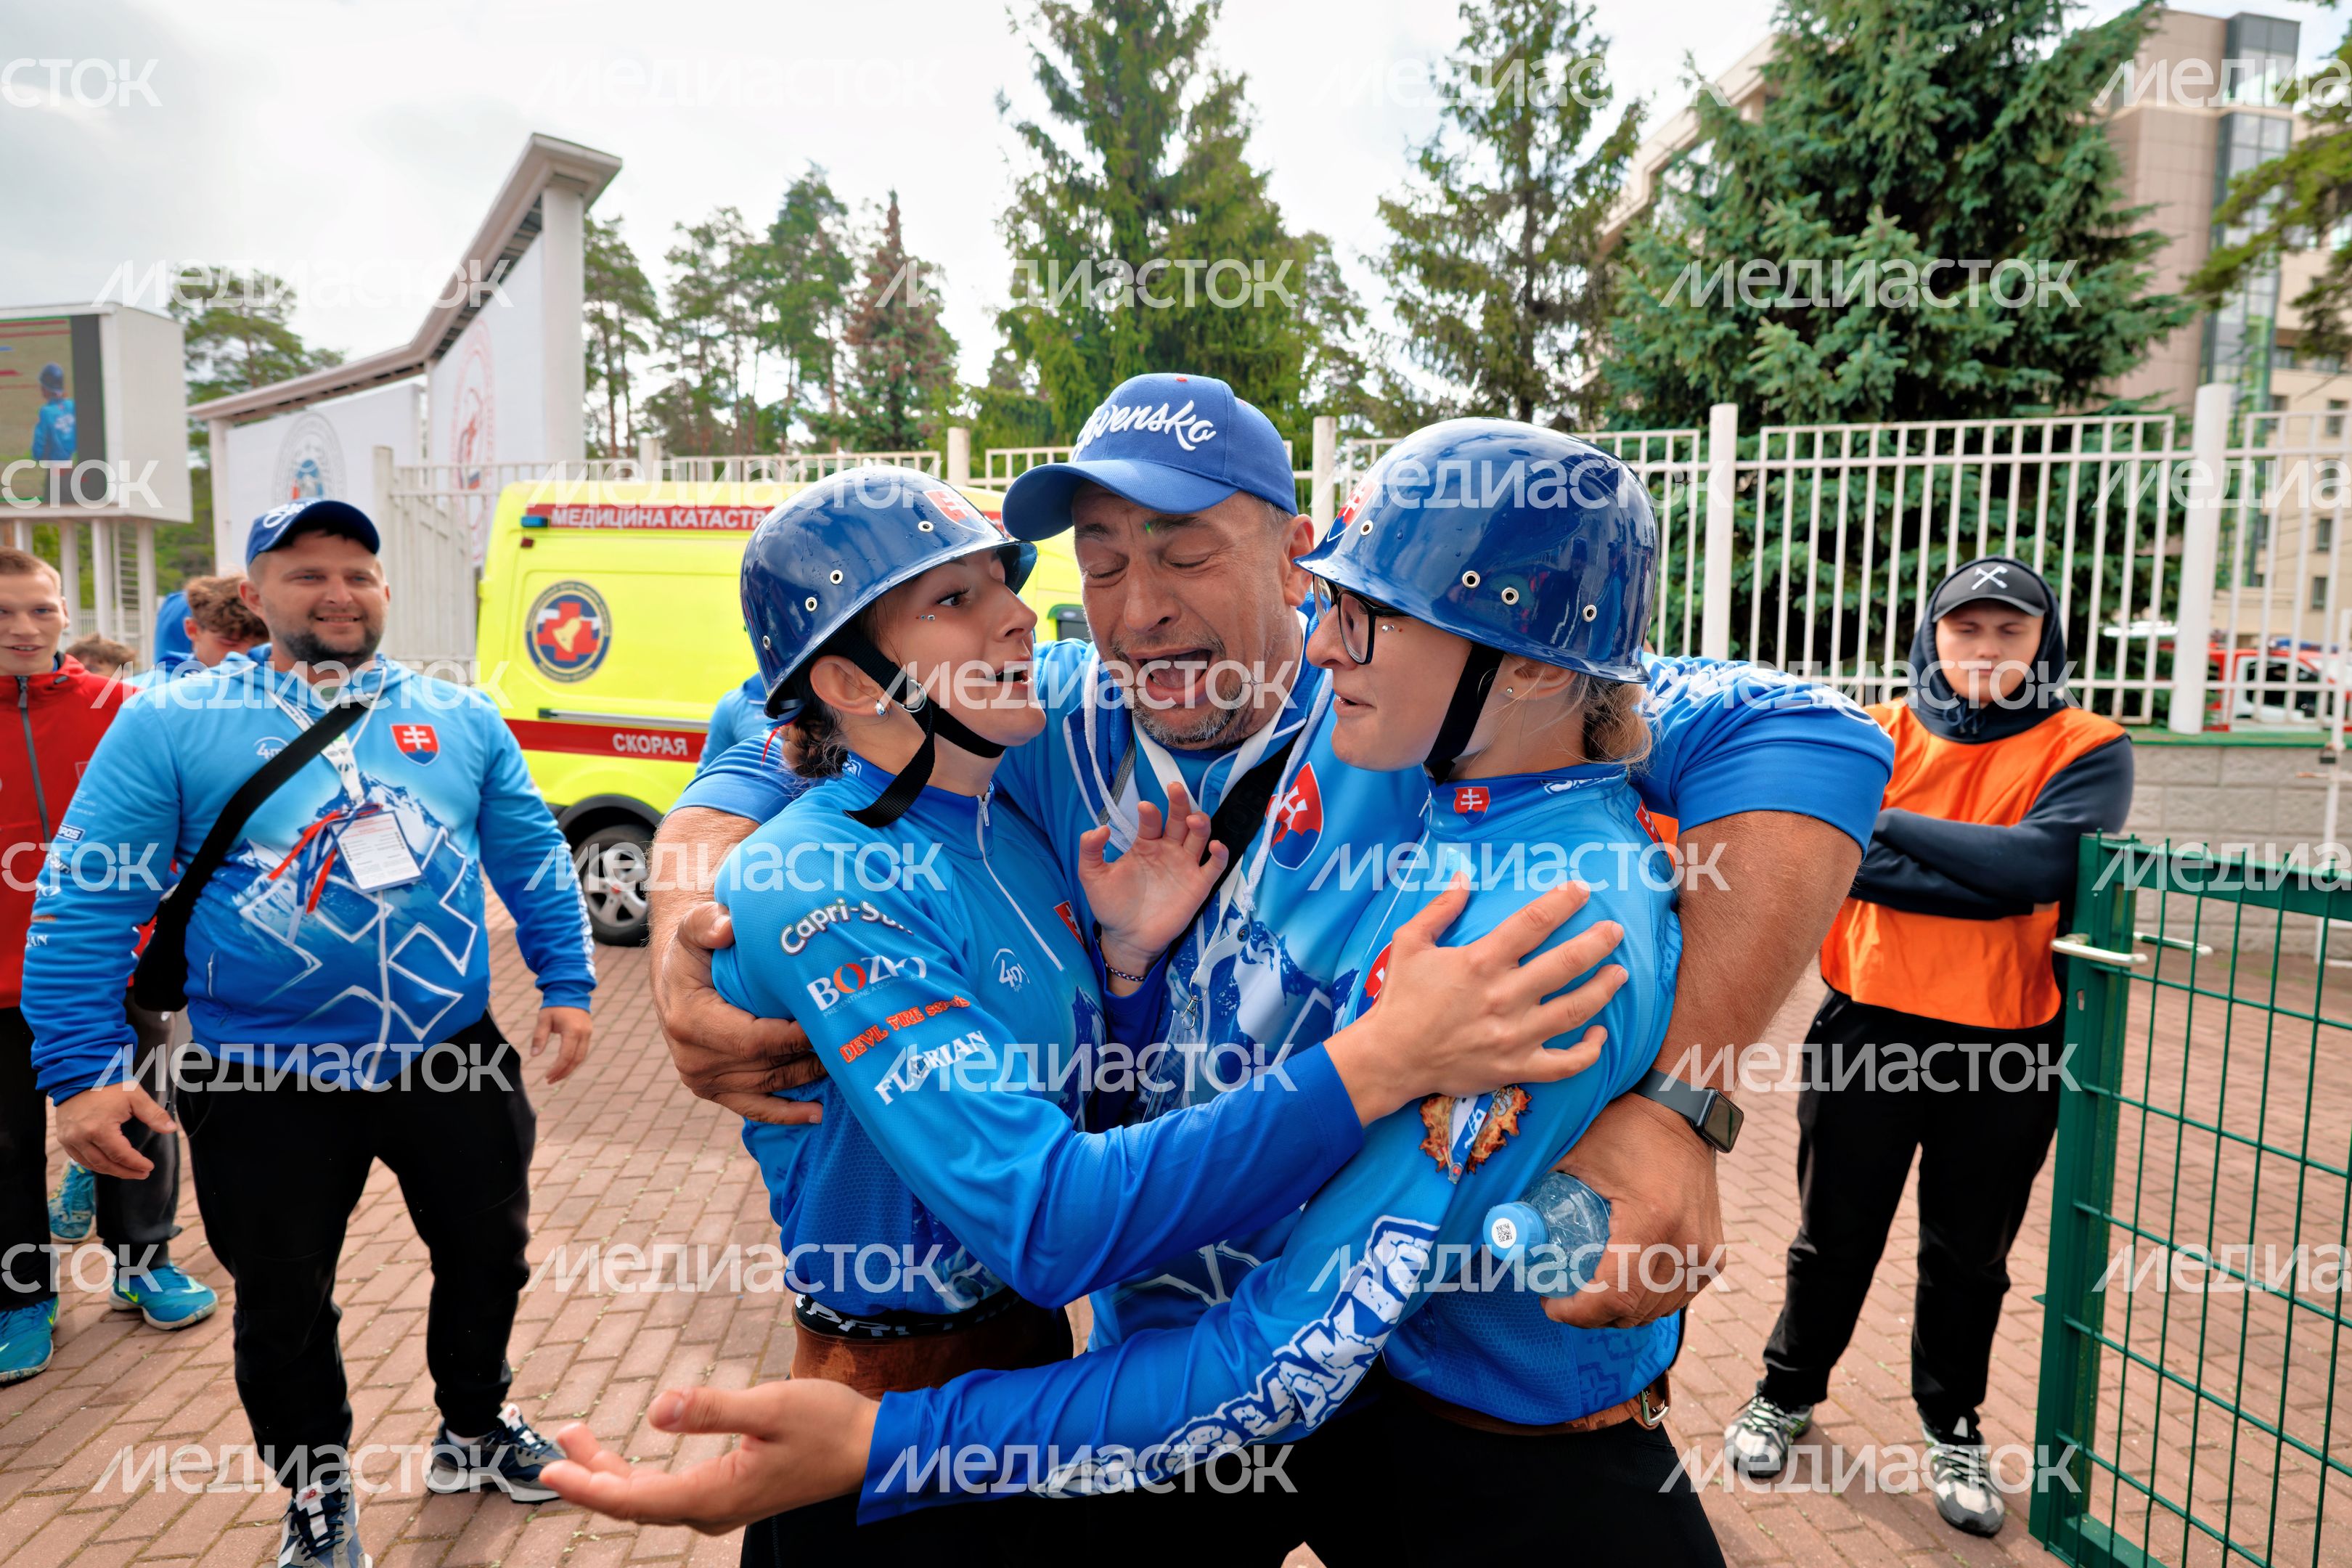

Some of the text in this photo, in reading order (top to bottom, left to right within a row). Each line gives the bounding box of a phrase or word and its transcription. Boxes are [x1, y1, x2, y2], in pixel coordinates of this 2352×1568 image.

[550, 508, 666, 528] МЕДИЦИНА
[613, 733, 688, 756] СКОРАЯ
[839, 1024, 889, 1063] DEVIL
[886, 1005, 926, 1031] FIRE
